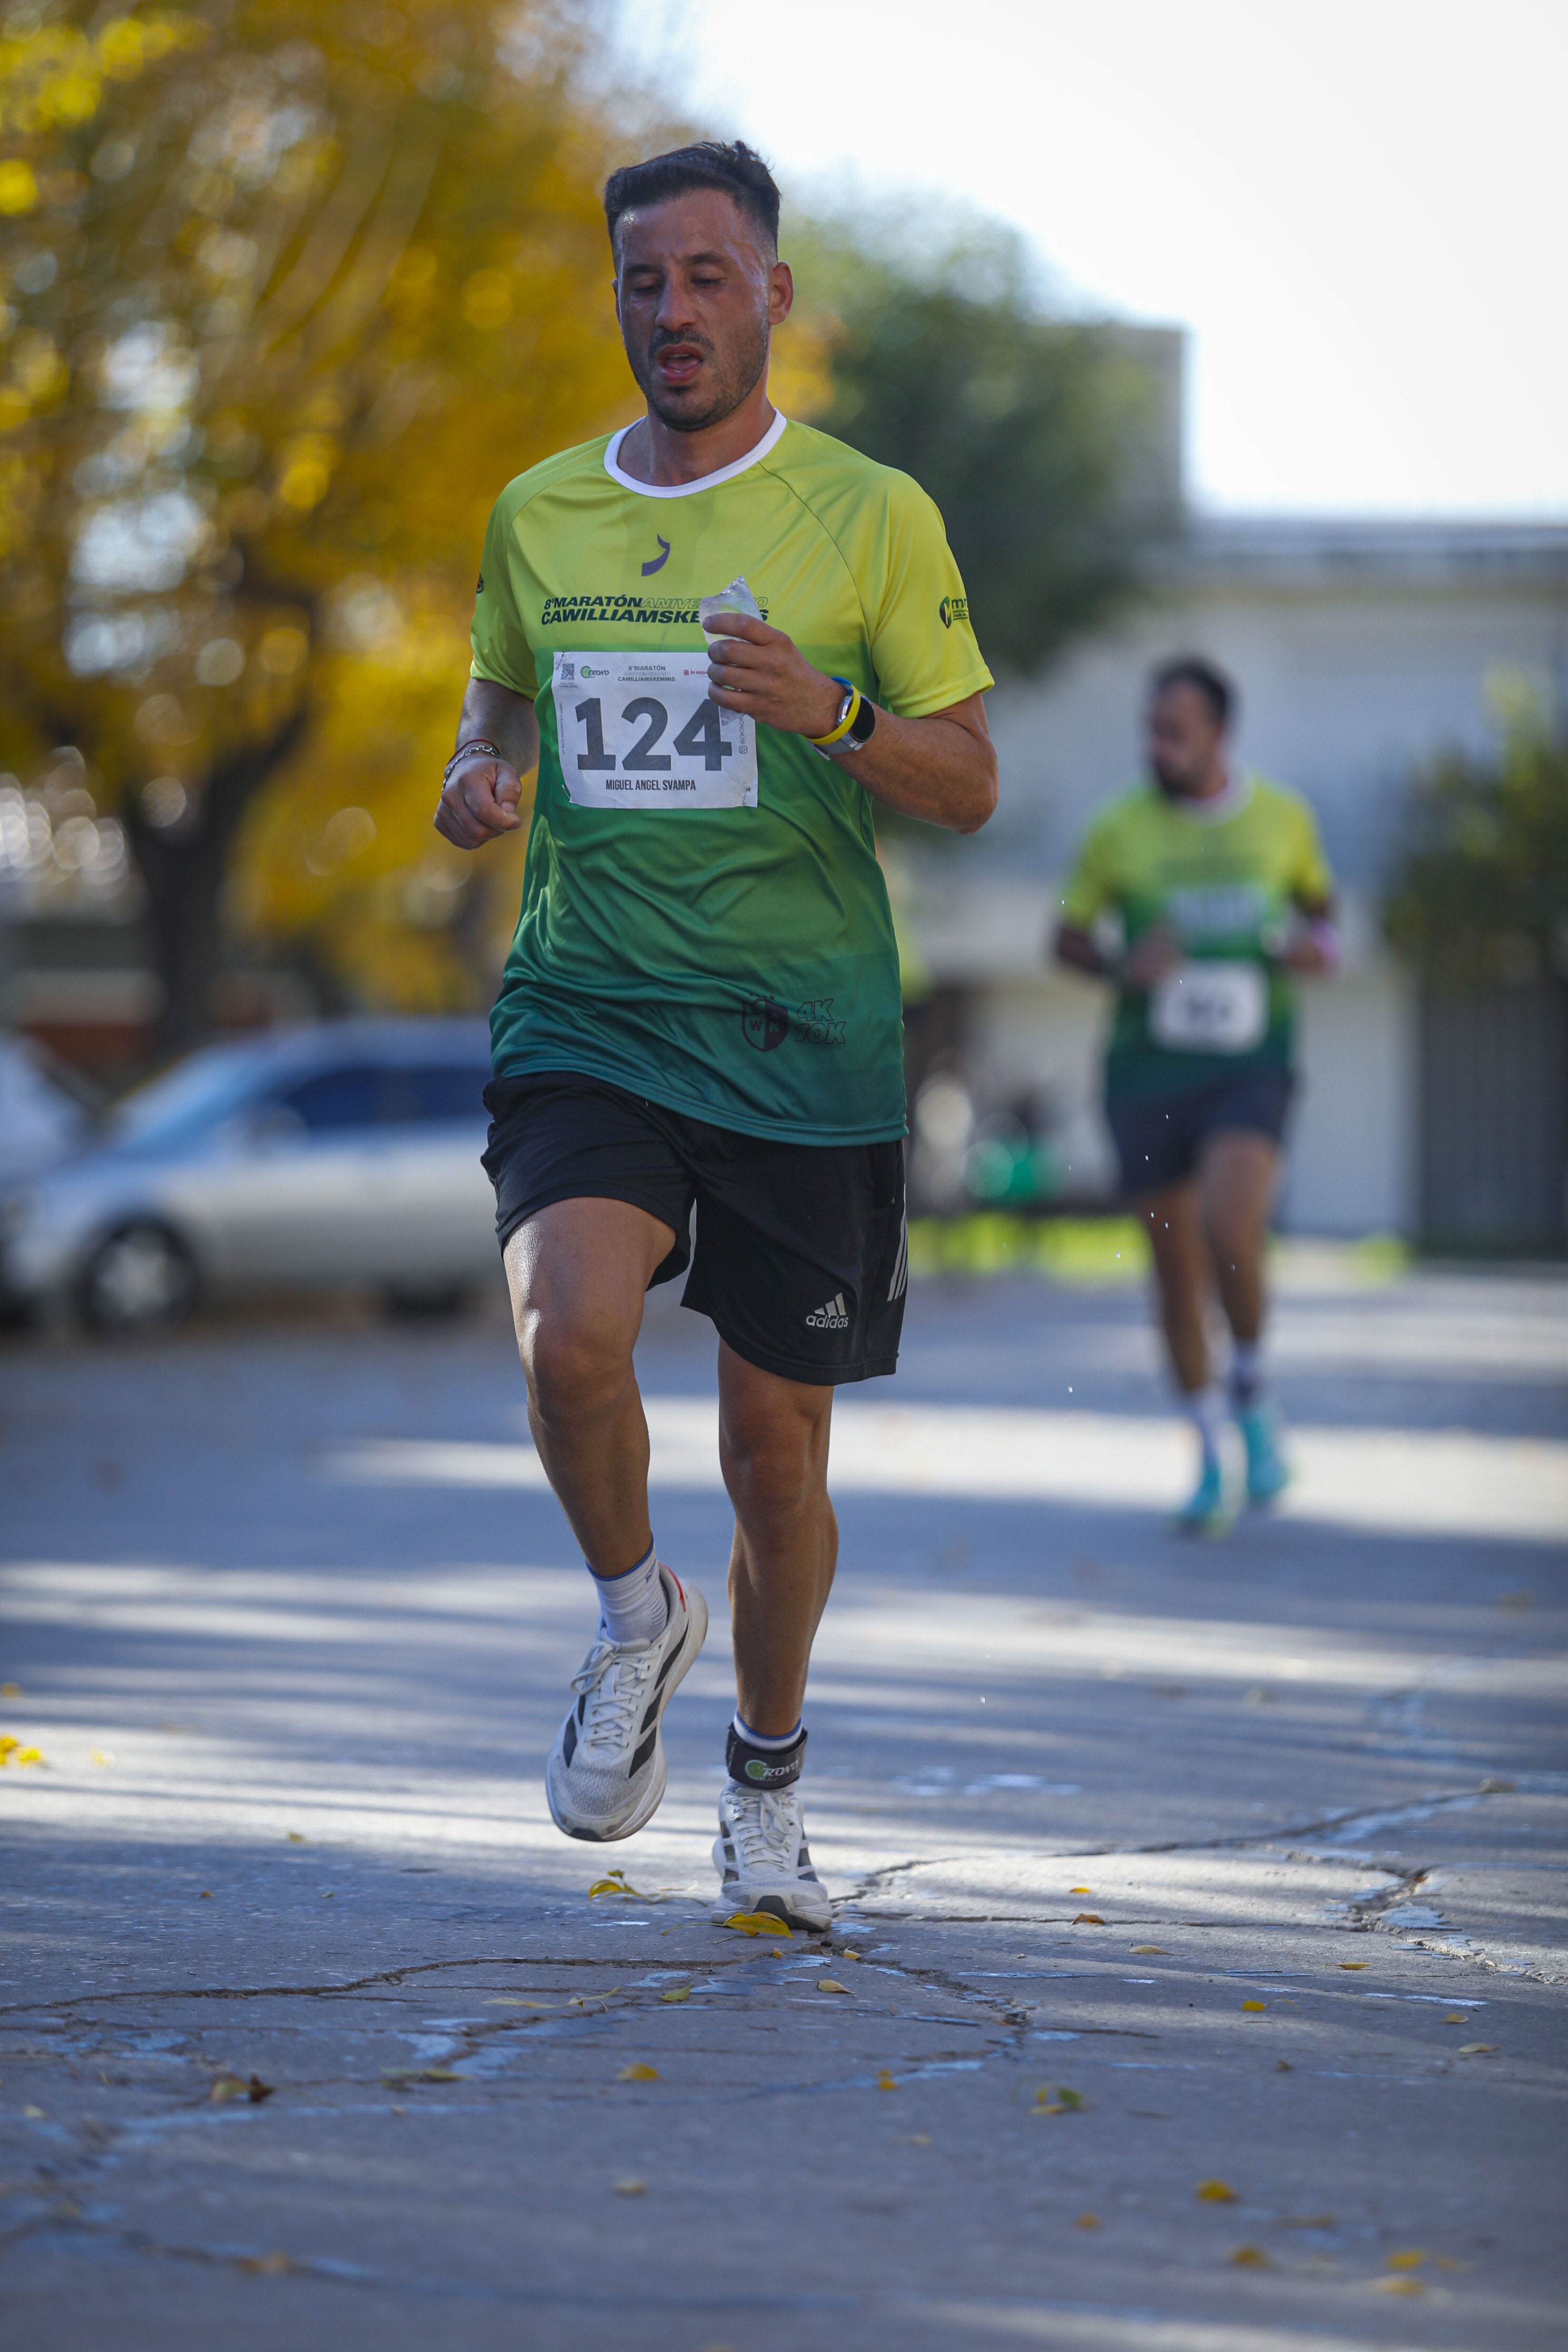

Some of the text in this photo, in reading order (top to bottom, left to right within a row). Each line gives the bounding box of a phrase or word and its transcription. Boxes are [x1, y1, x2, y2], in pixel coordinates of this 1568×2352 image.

[641, 596, 768, 609] ANIVEO
[541, 608, 769, 625] CAWILLIAMSKES
[575, 697, 733, 771] 124
[606, 779, 696, 790] MIGUEL ANGEL SVAMPA
[796, 998, 834, 1022] 4K
[806, 1315, 849, 1328] adidas
